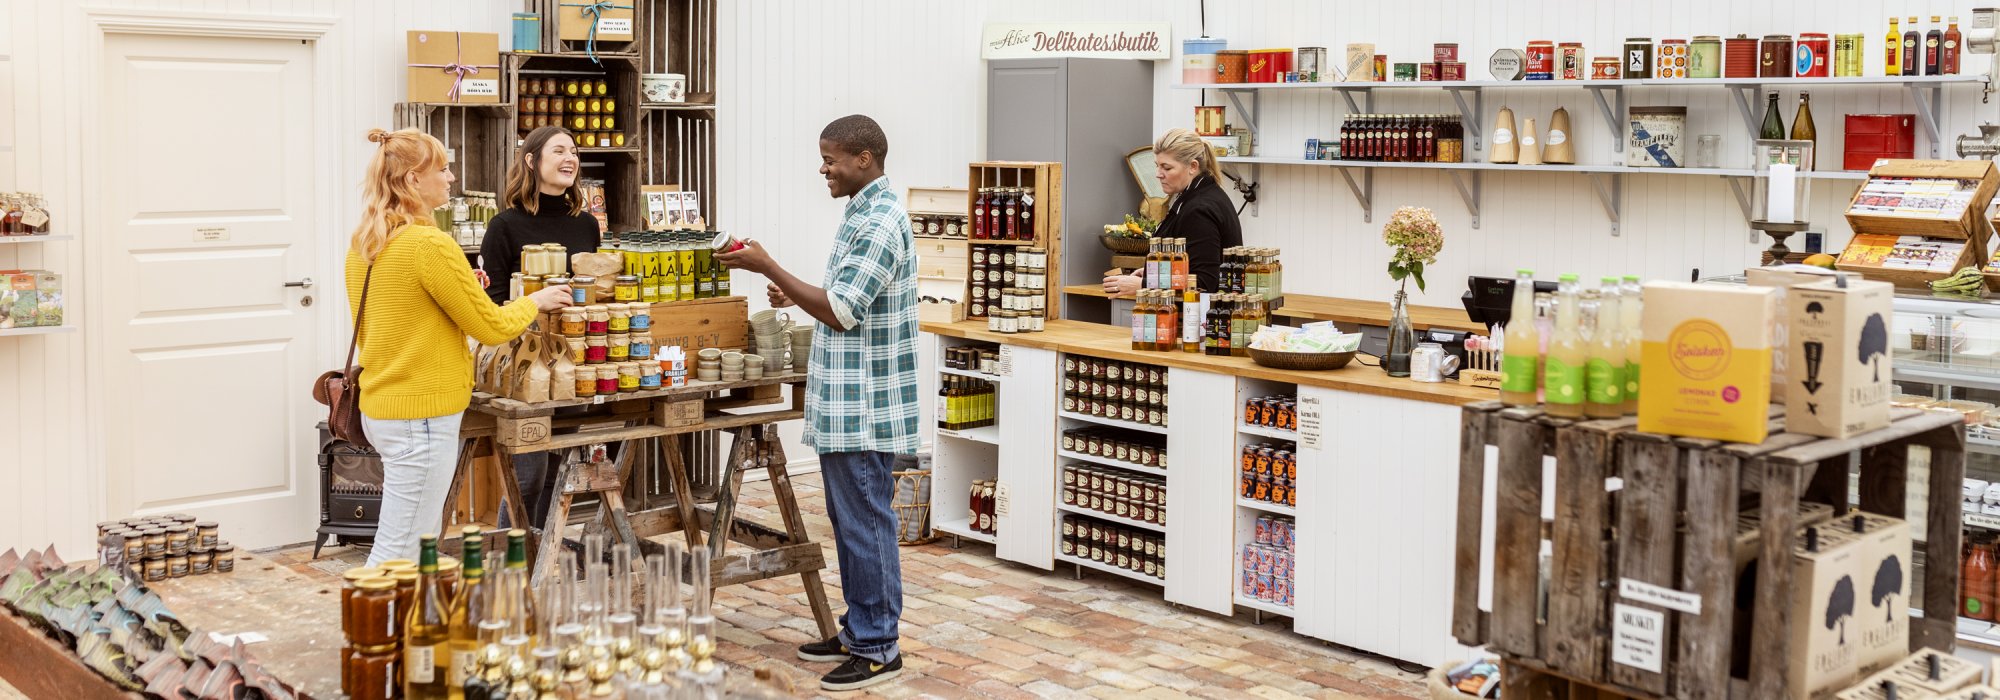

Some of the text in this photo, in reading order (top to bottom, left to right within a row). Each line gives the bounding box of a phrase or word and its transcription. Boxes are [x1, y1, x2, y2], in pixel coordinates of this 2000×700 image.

[995, 29, 1030, 49] Alice
[1032, 30, 1159, 52] Delikatessbutik
[521, 426, 543, 438] EPAL
